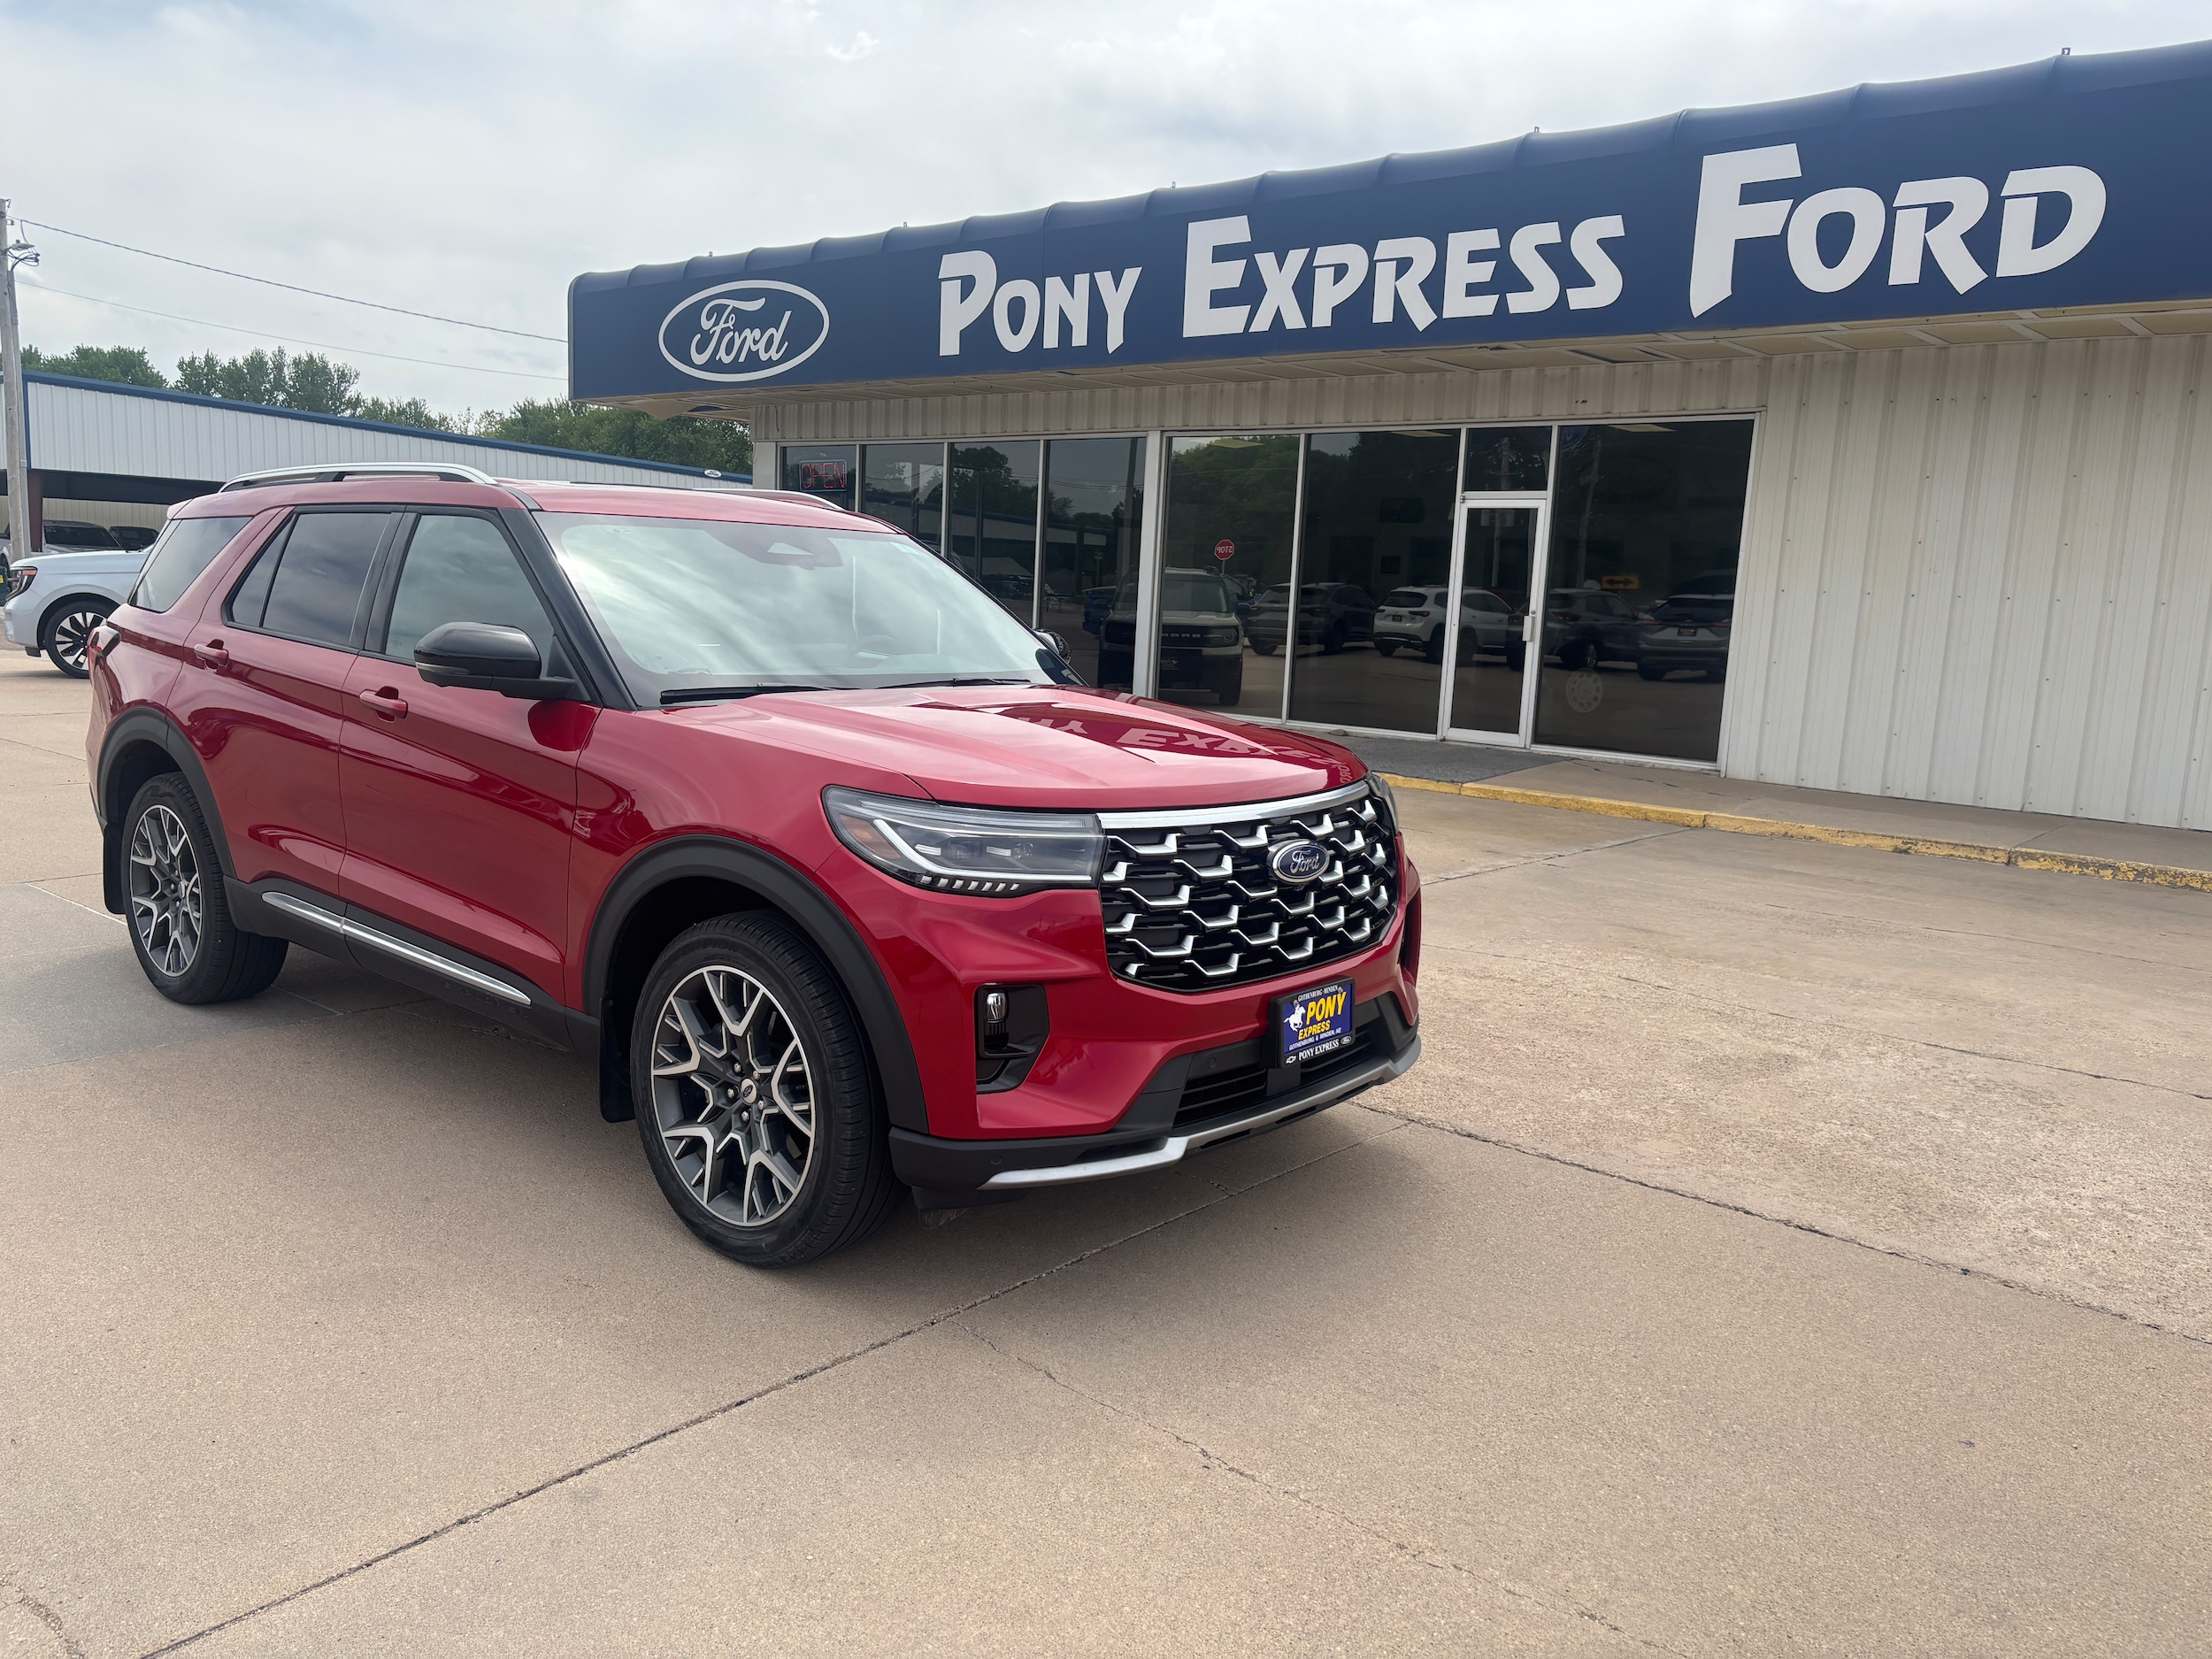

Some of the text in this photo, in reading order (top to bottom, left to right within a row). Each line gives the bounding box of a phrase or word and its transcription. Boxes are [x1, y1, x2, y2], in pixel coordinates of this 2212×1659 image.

[691, 298, 791, 365] Ford
[802, 463, 845, 488] OPEN
[1290, 849, 1319, 873] Ford
[1306, 992, 1347, 1025] PONY
[1298, 1020, 1331, 1041] EXPRESS
[1299, 1048, 1315, 1061] PONY
[1315, 1039, 1340, 1055] EXPRESS
